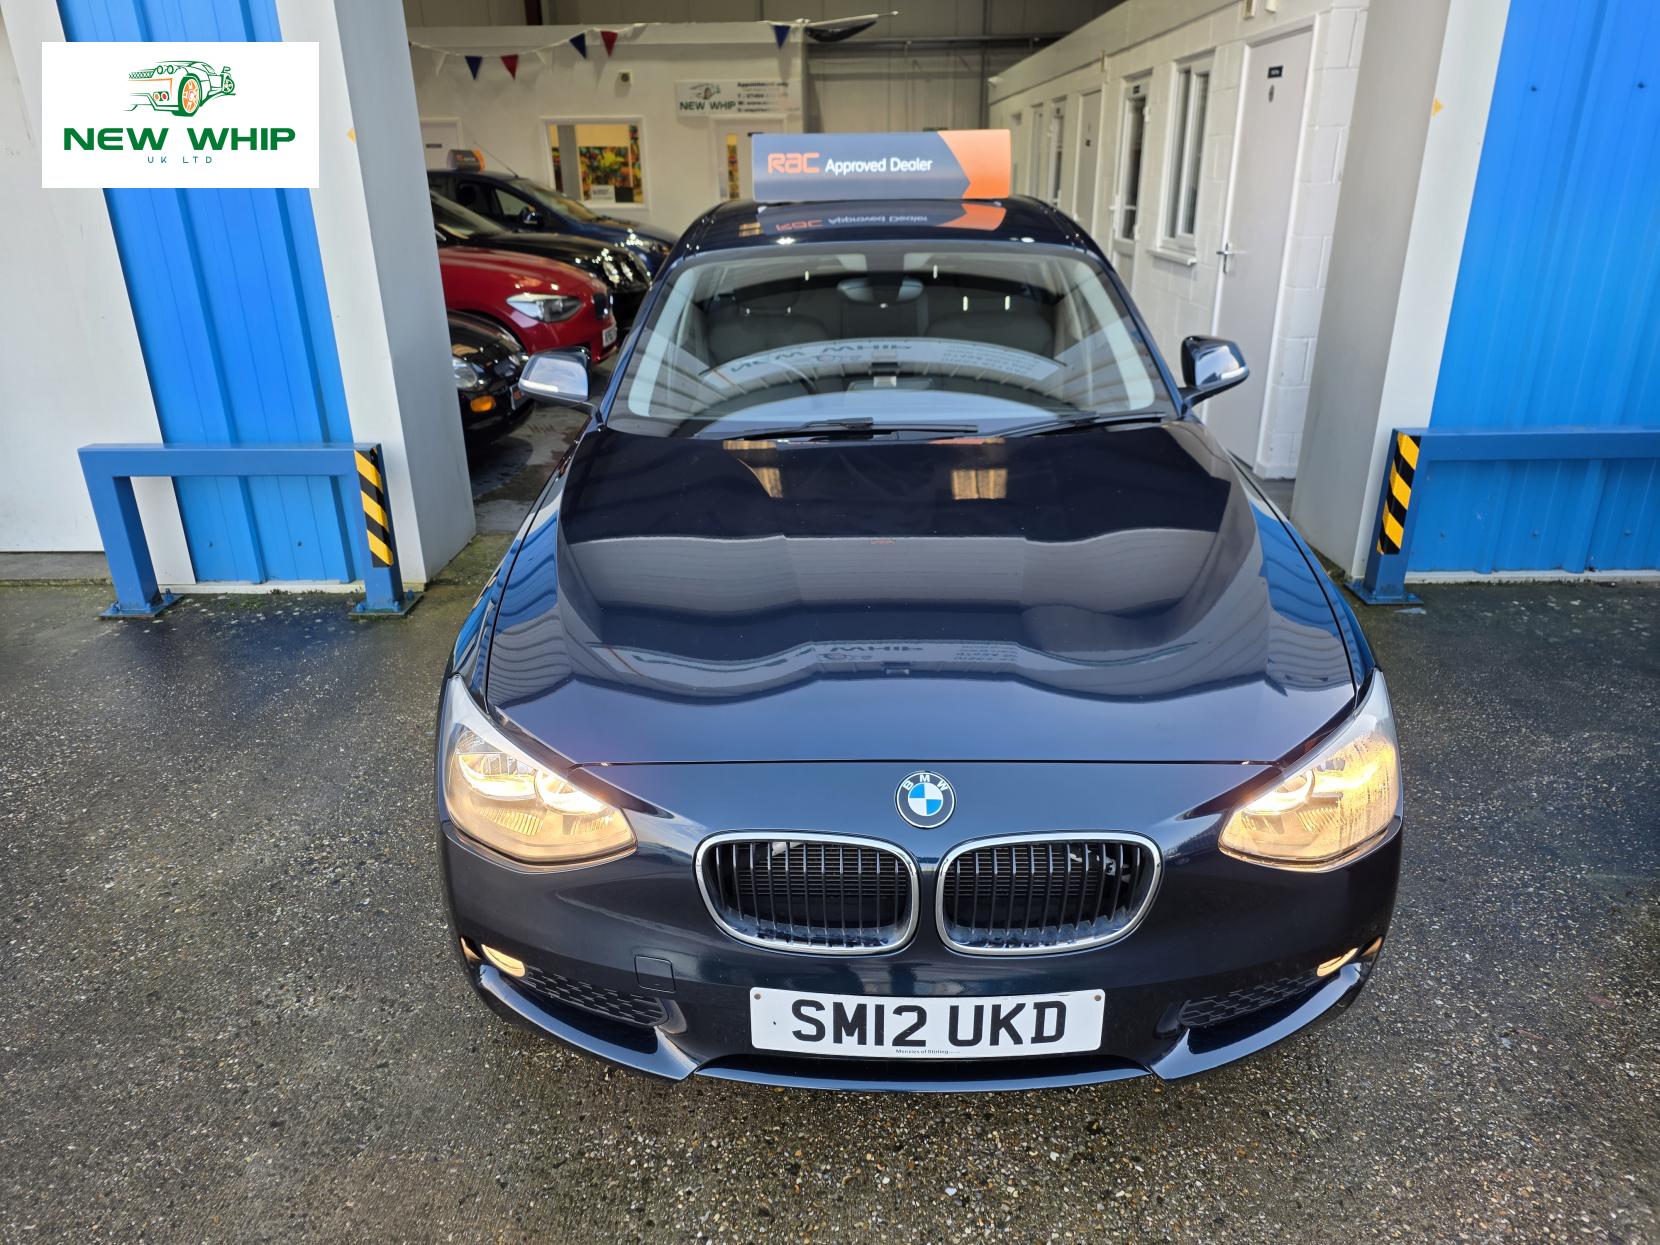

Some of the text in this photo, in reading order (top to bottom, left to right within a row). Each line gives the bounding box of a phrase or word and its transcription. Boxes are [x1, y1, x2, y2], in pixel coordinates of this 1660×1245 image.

[679, 101, 706, 111] NEW
[709, 101, 736, 111] WHIP
[824, 158, 887, 176] Approved
[889, 157, 933, 173] Dealer
[902, 774, 949, 792] BMW
[791, 998, 1067, 1048] SM12 UKD
